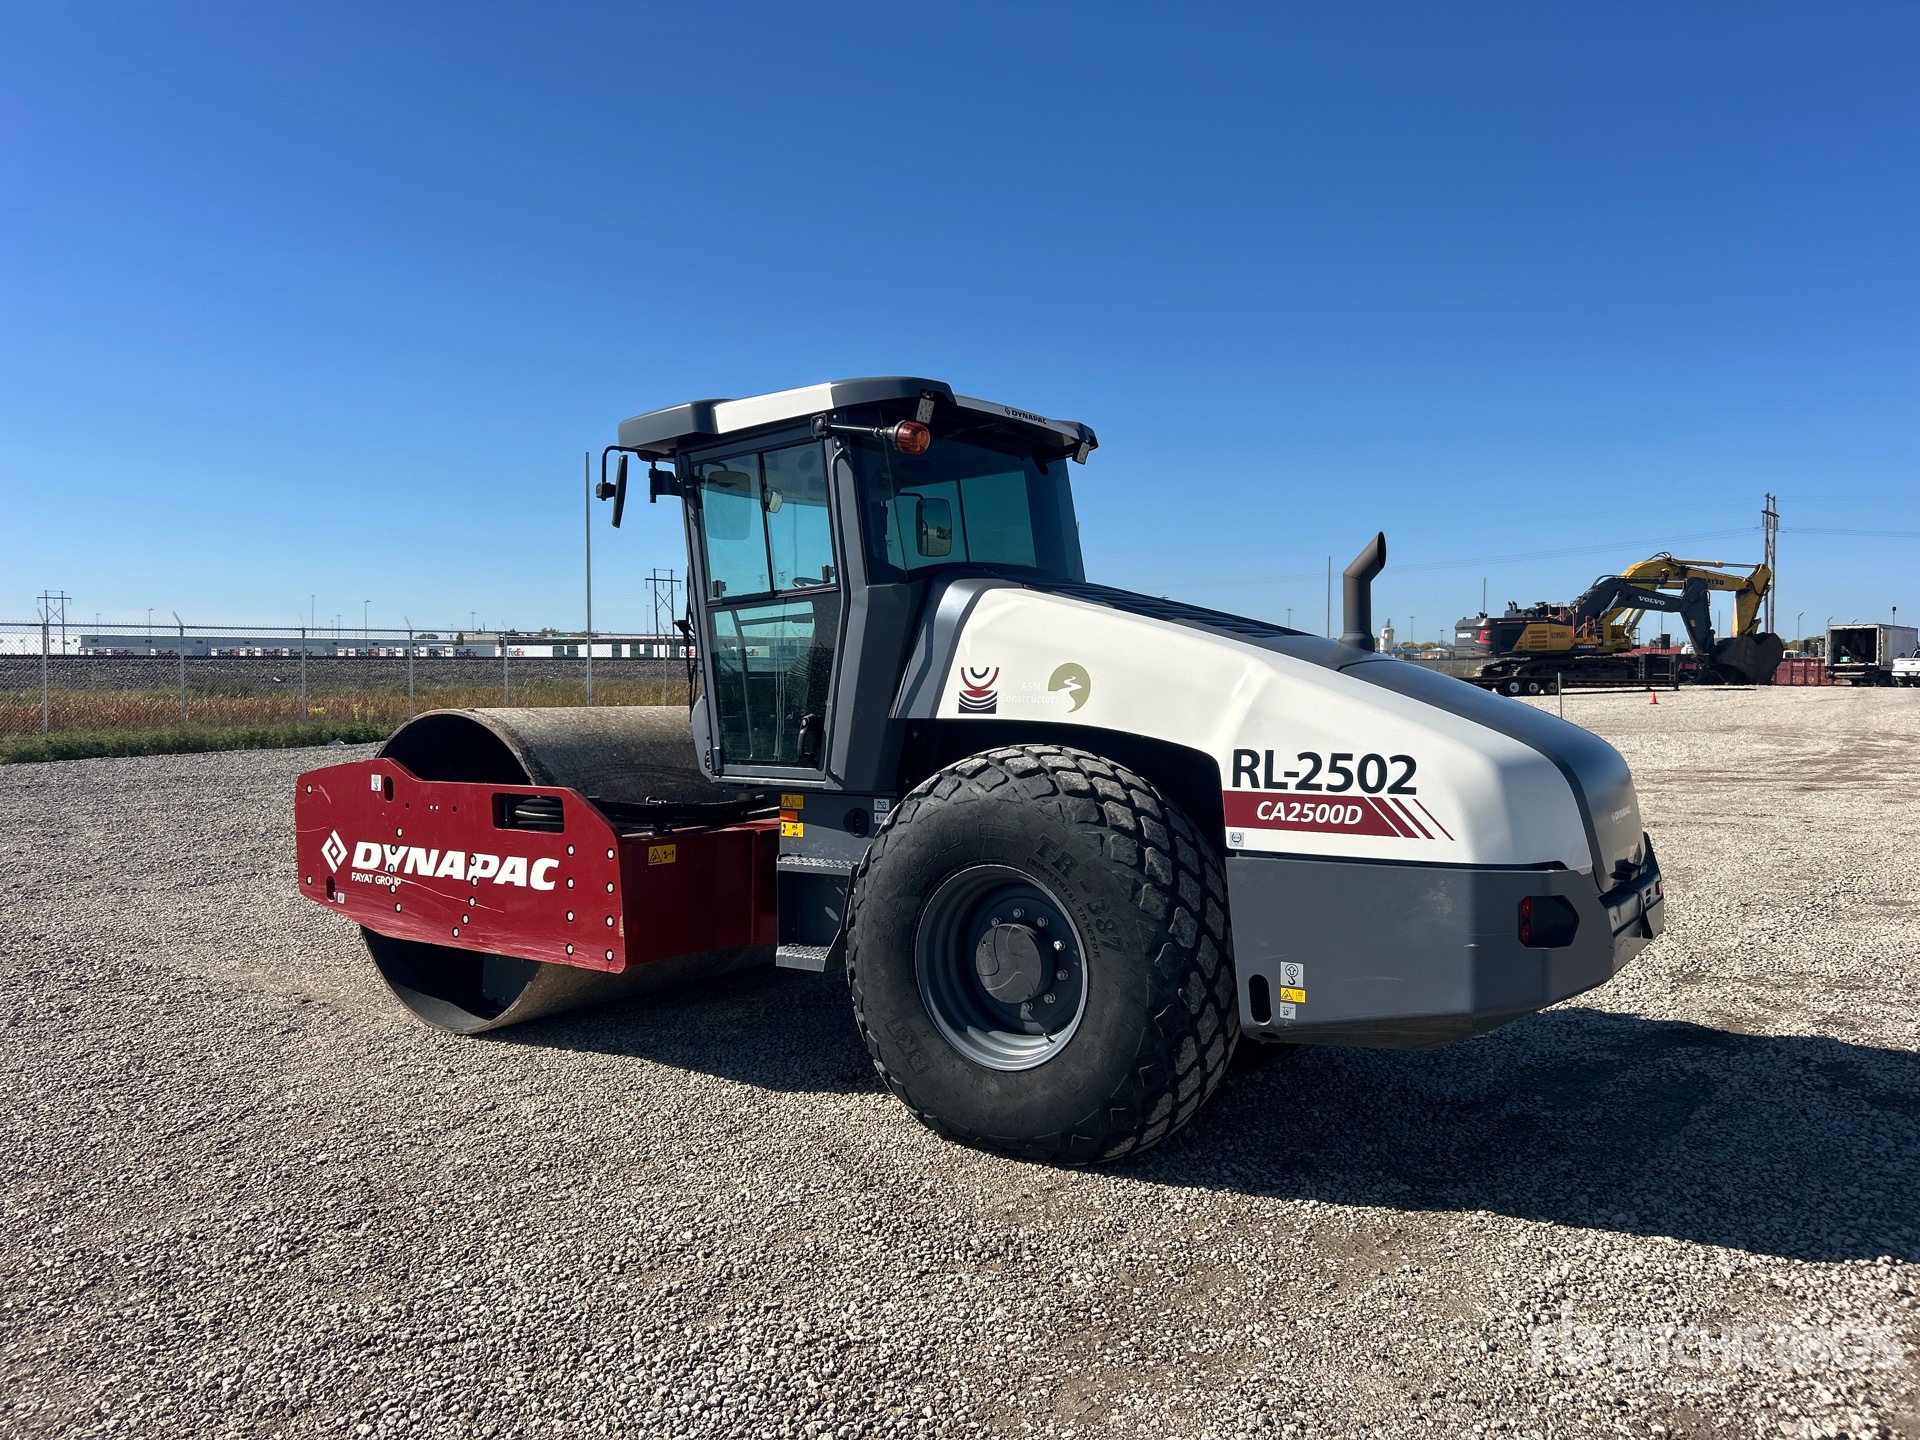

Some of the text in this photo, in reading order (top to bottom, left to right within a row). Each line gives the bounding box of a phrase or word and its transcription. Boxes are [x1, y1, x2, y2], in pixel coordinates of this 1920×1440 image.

[1011, 409, 1047, 425] DYNAPAC
[1637, 595, 1666, 606] VOLVO
[507, 647, 525, 657] FedEx
[1020, 681, 1041, 692] ASN
[1000, 692, 1060, 704] Constructors
[1231, 748, 1417, 796] RL-2502
[1256, 800, 1363, 826] CA2500D
[351, 841, 560, 891] DYNAPAC
[351, 872, 373, 883] FAYAT
[375, 875, 401, 887] GROUP
